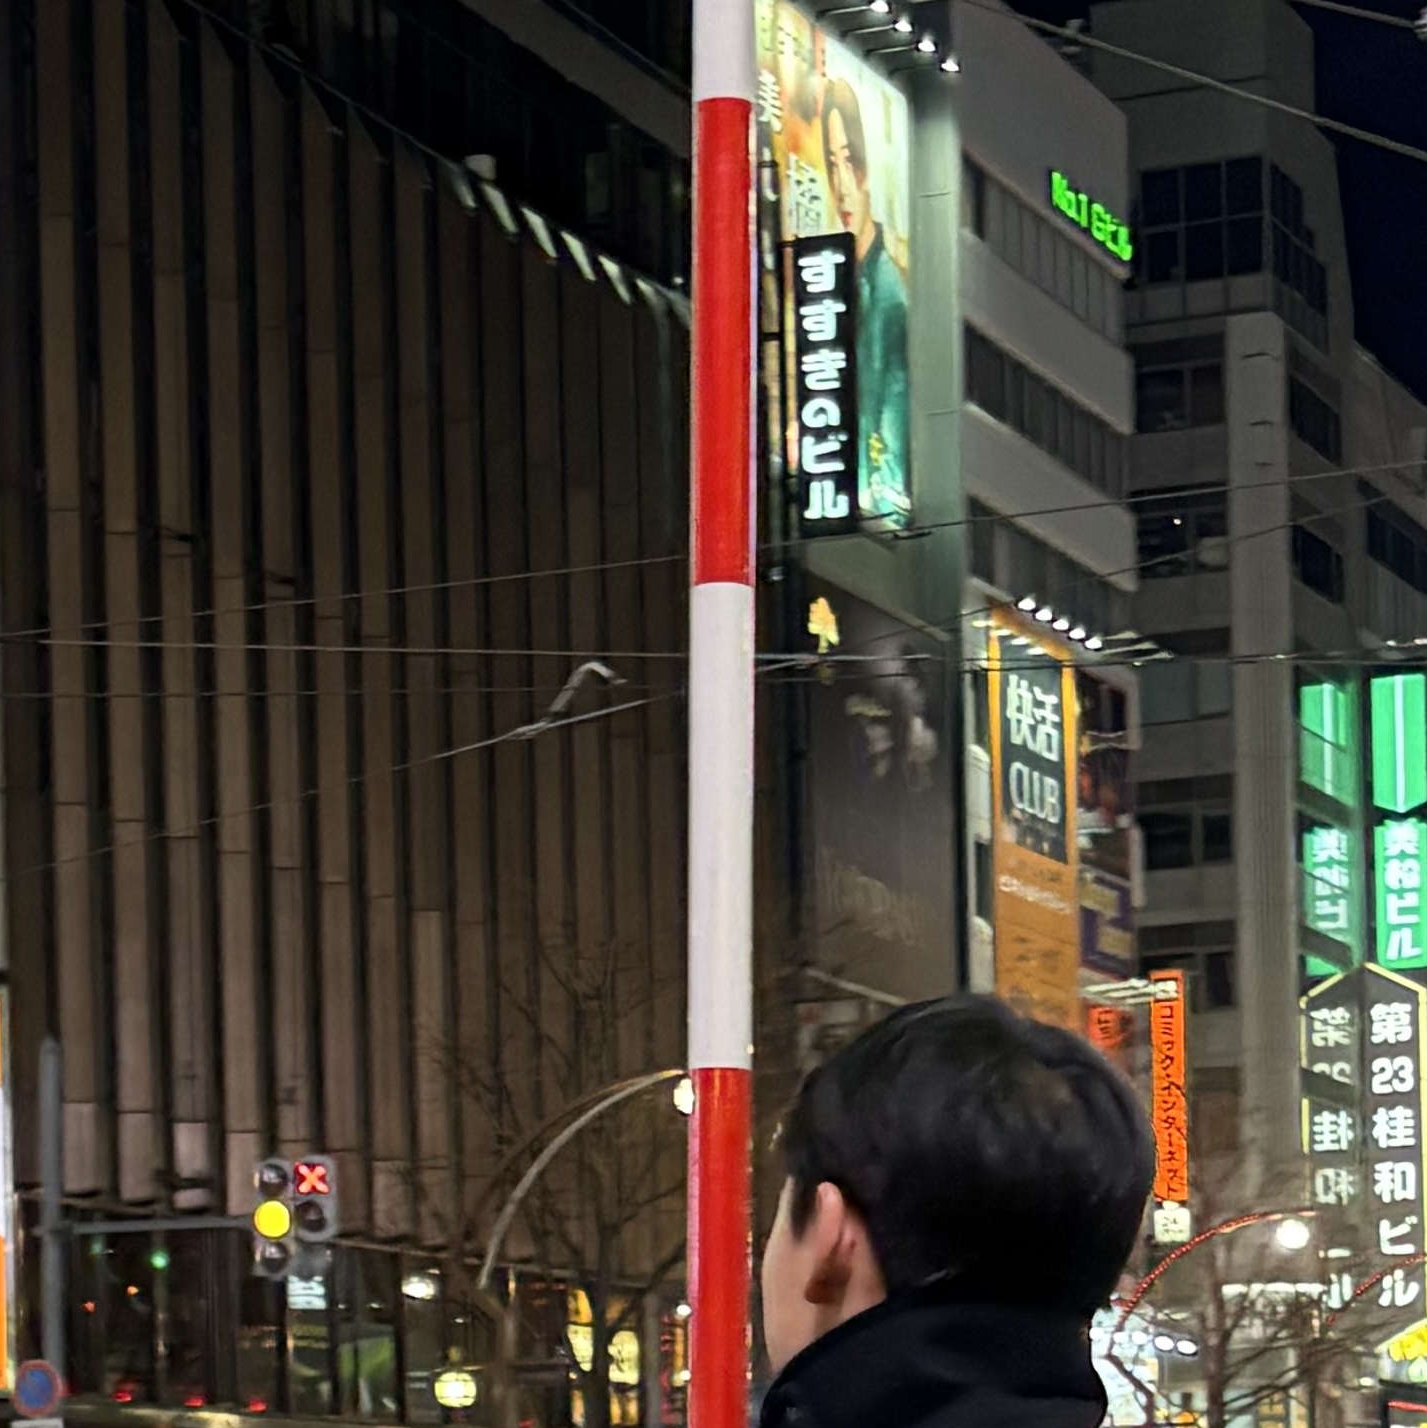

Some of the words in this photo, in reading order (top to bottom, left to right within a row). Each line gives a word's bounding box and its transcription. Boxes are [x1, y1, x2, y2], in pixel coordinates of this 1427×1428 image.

[798, 251, 850, 520] すすきのビル
[1006, 674, 1061, 762] 快活
[1009, 761, 1060, 824] CLUB
[1370, 1002, 1419, 1306] 第23桂和ビル
